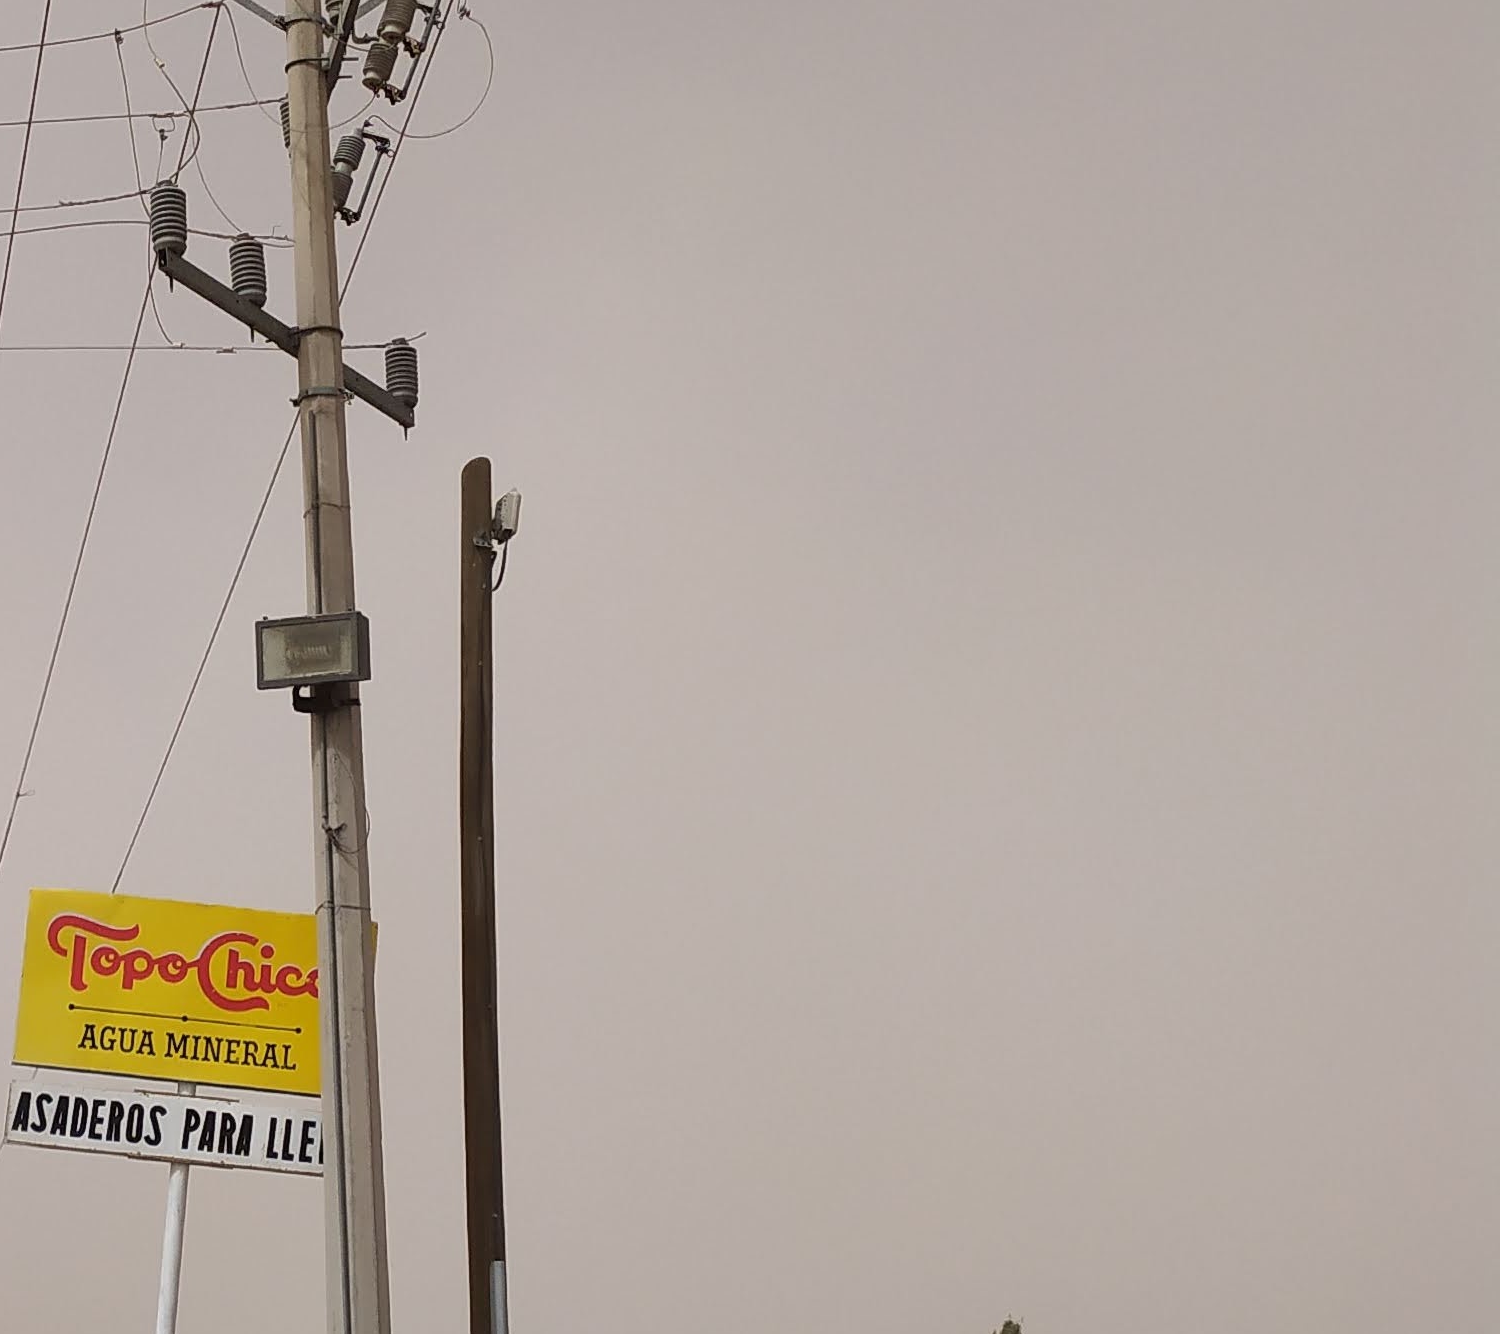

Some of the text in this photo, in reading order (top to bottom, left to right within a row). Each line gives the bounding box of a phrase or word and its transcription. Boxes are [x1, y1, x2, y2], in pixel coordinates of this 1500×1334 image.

[48, 914, 192, 992] Topo
[77, 1023, 297, 1071] AGUA MINERAL
[10, 1091, 324, 1165] ASADEROS PARA LLE
